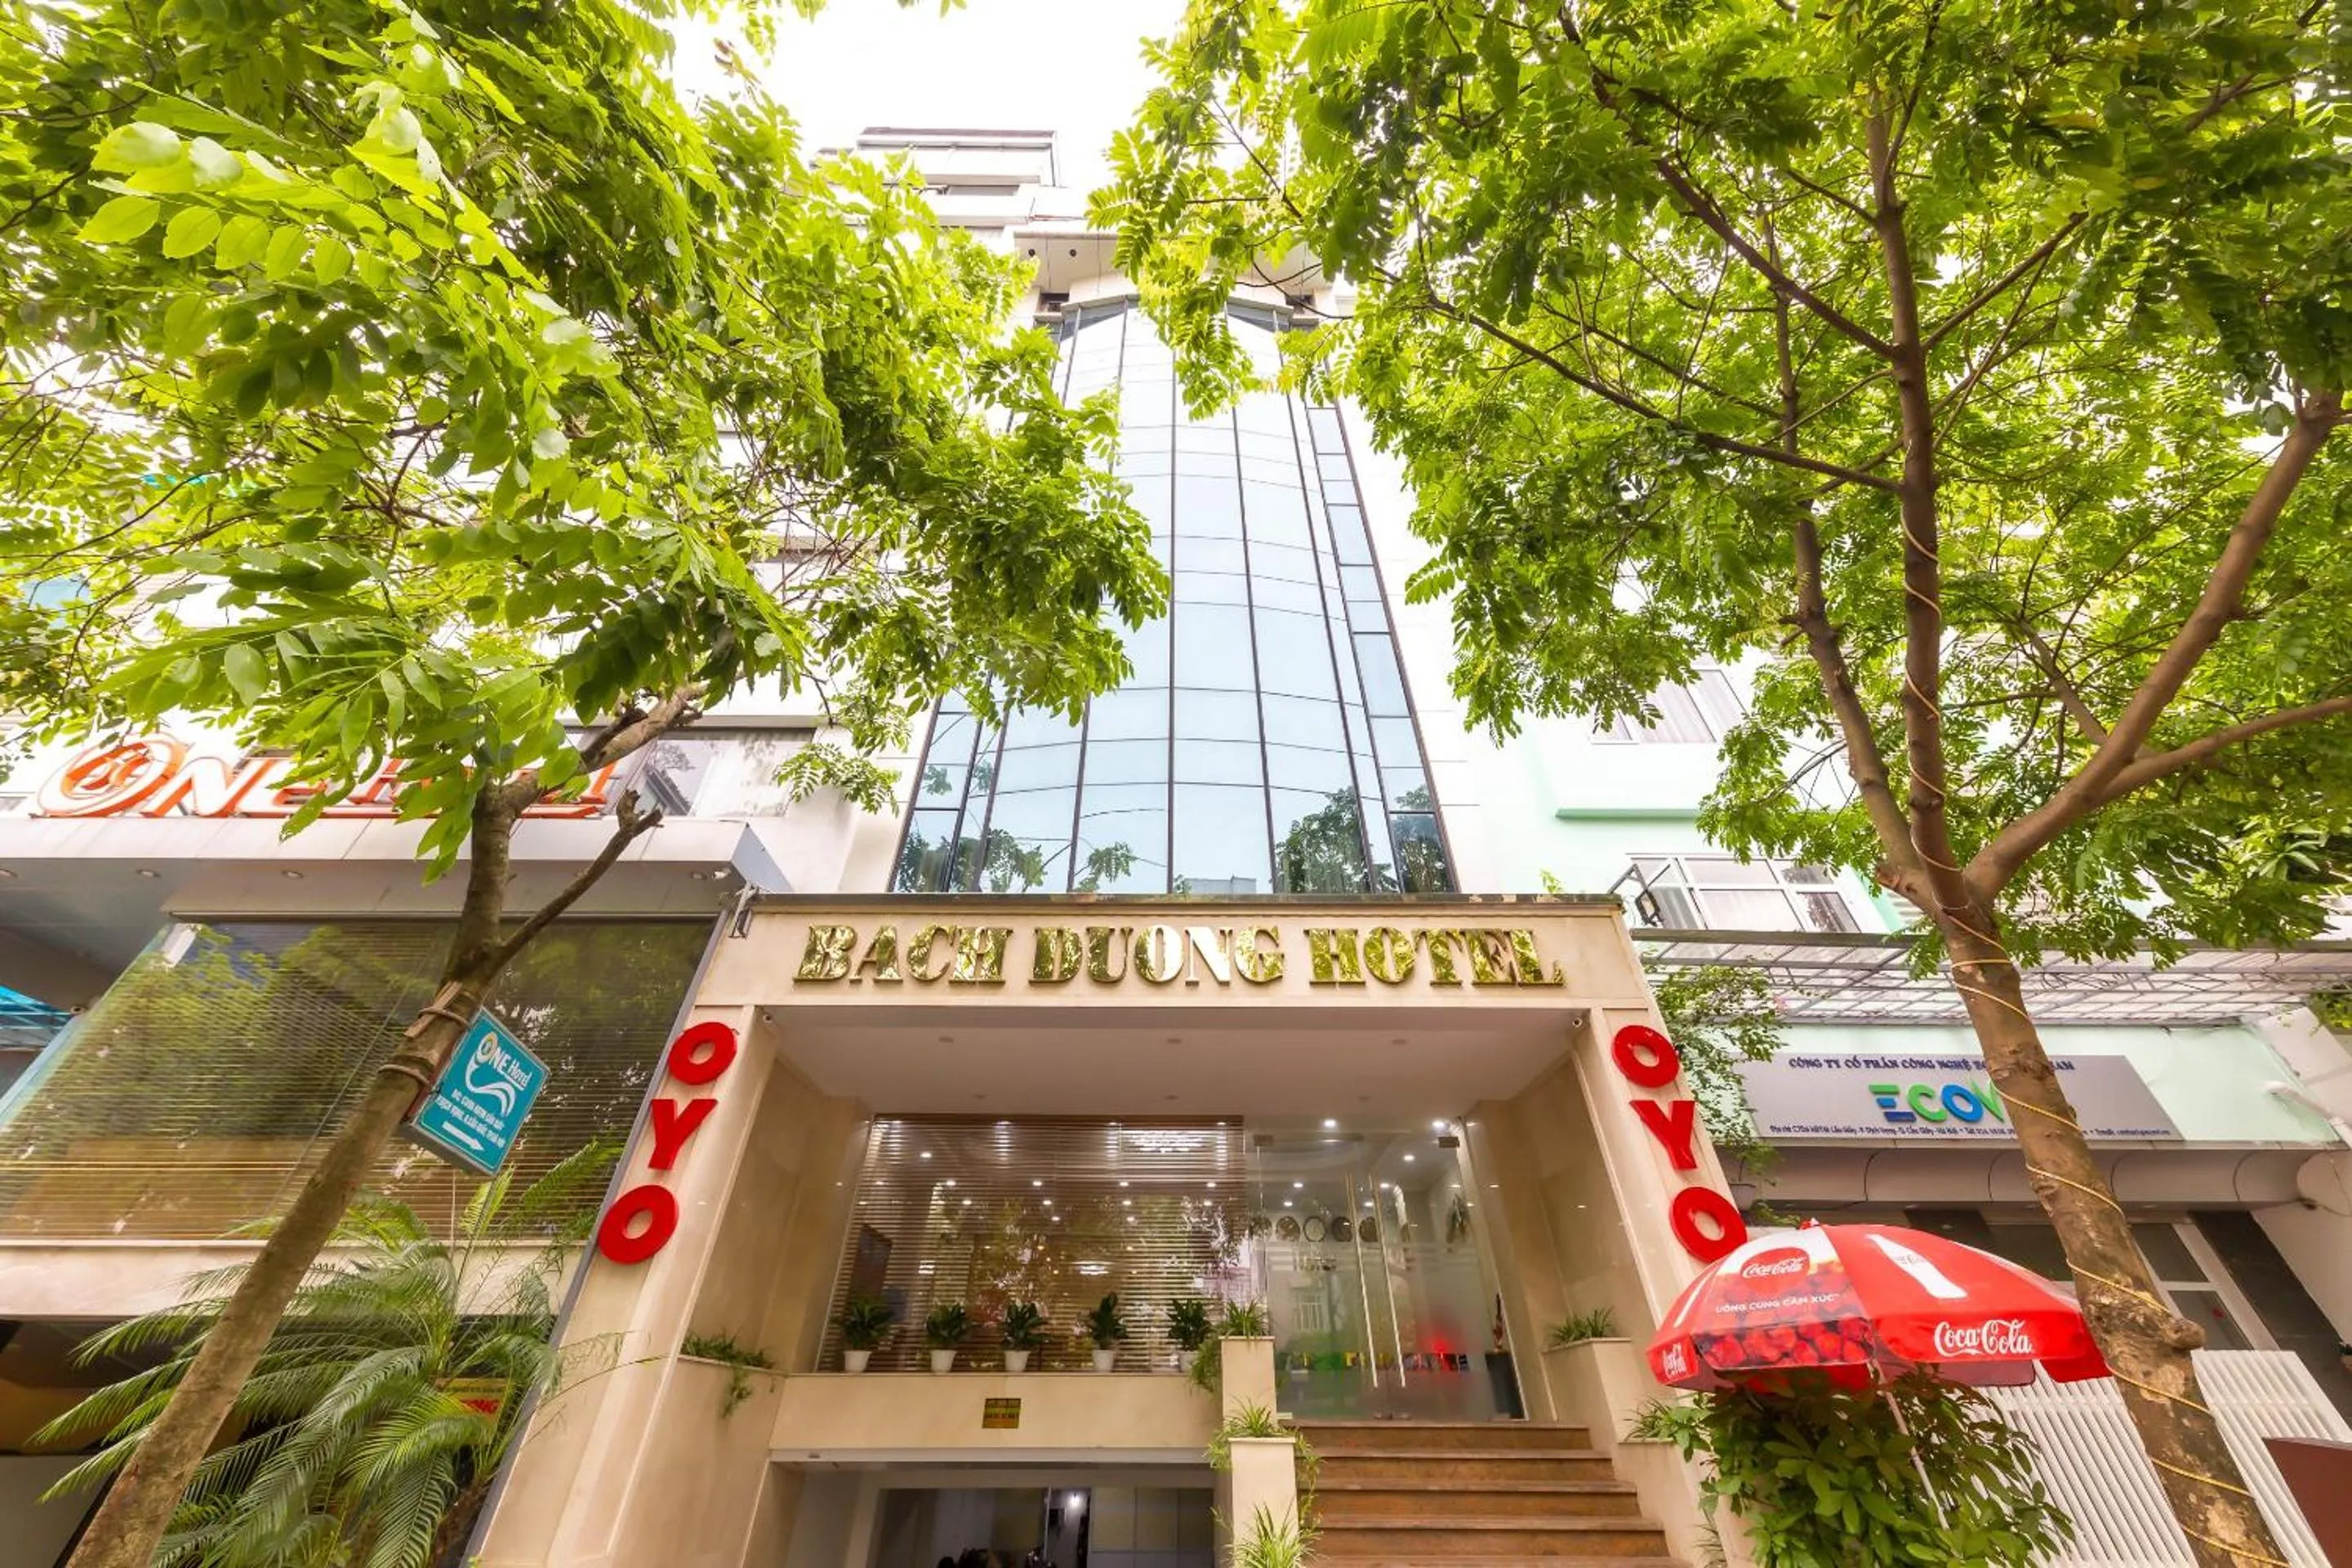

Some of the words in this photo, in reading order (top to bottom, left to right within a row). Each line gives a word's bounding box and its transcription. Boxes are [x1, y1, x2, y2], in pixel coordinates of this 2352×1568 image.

[792, 924, 1013, 984] BACH
[1028, 924, 1285, 987] DUONG
[1303, 925, 1565, 987] HOTEL
[597, 1021, 737, 1265] OYO
[1611, 1024, 1748, 1263] OYO
[1934, 1319, 2033, 1357] Coca-Cola
